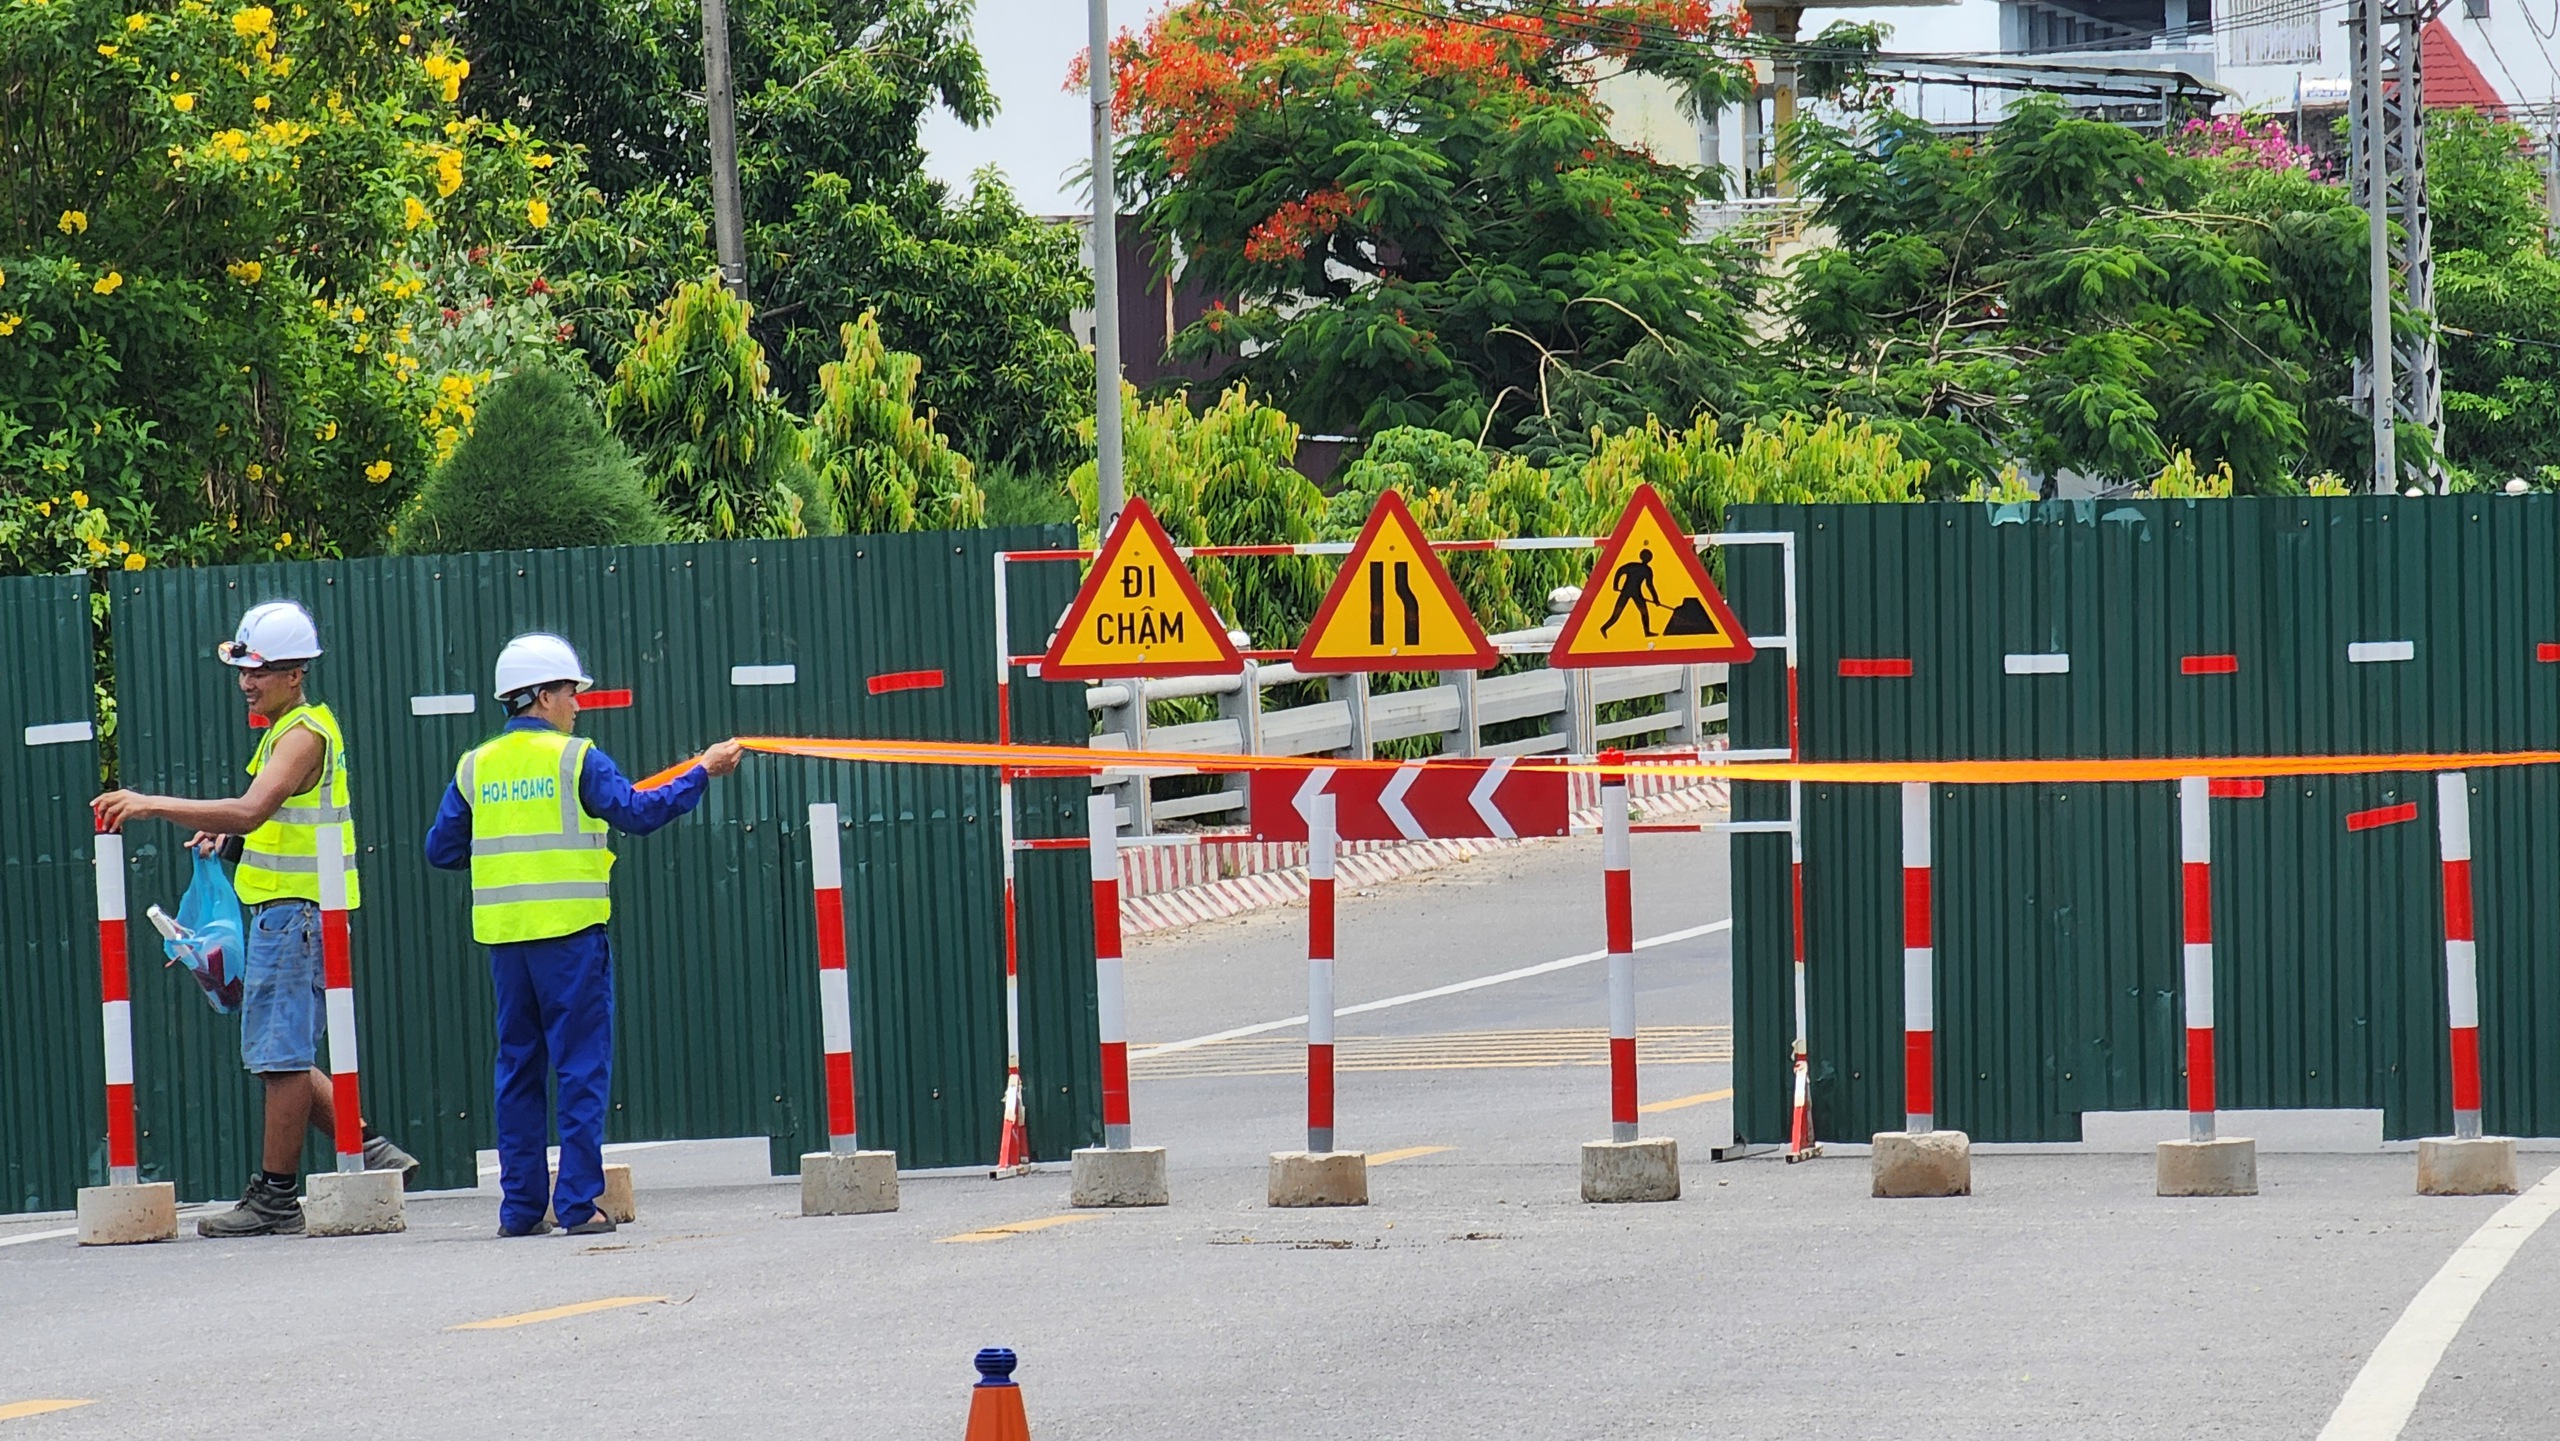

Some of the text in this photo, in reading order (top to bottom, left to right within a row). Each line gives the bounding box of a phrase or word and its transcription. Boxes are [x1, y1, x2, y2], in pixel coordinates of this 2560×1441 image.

[2382, 418, 2391, 429] 2
[1120, 565, 1156, 598] ĐI
[1097, 605, 1184, 650] CHẬM
[482, 777, 554, 804] HOA HOANG
